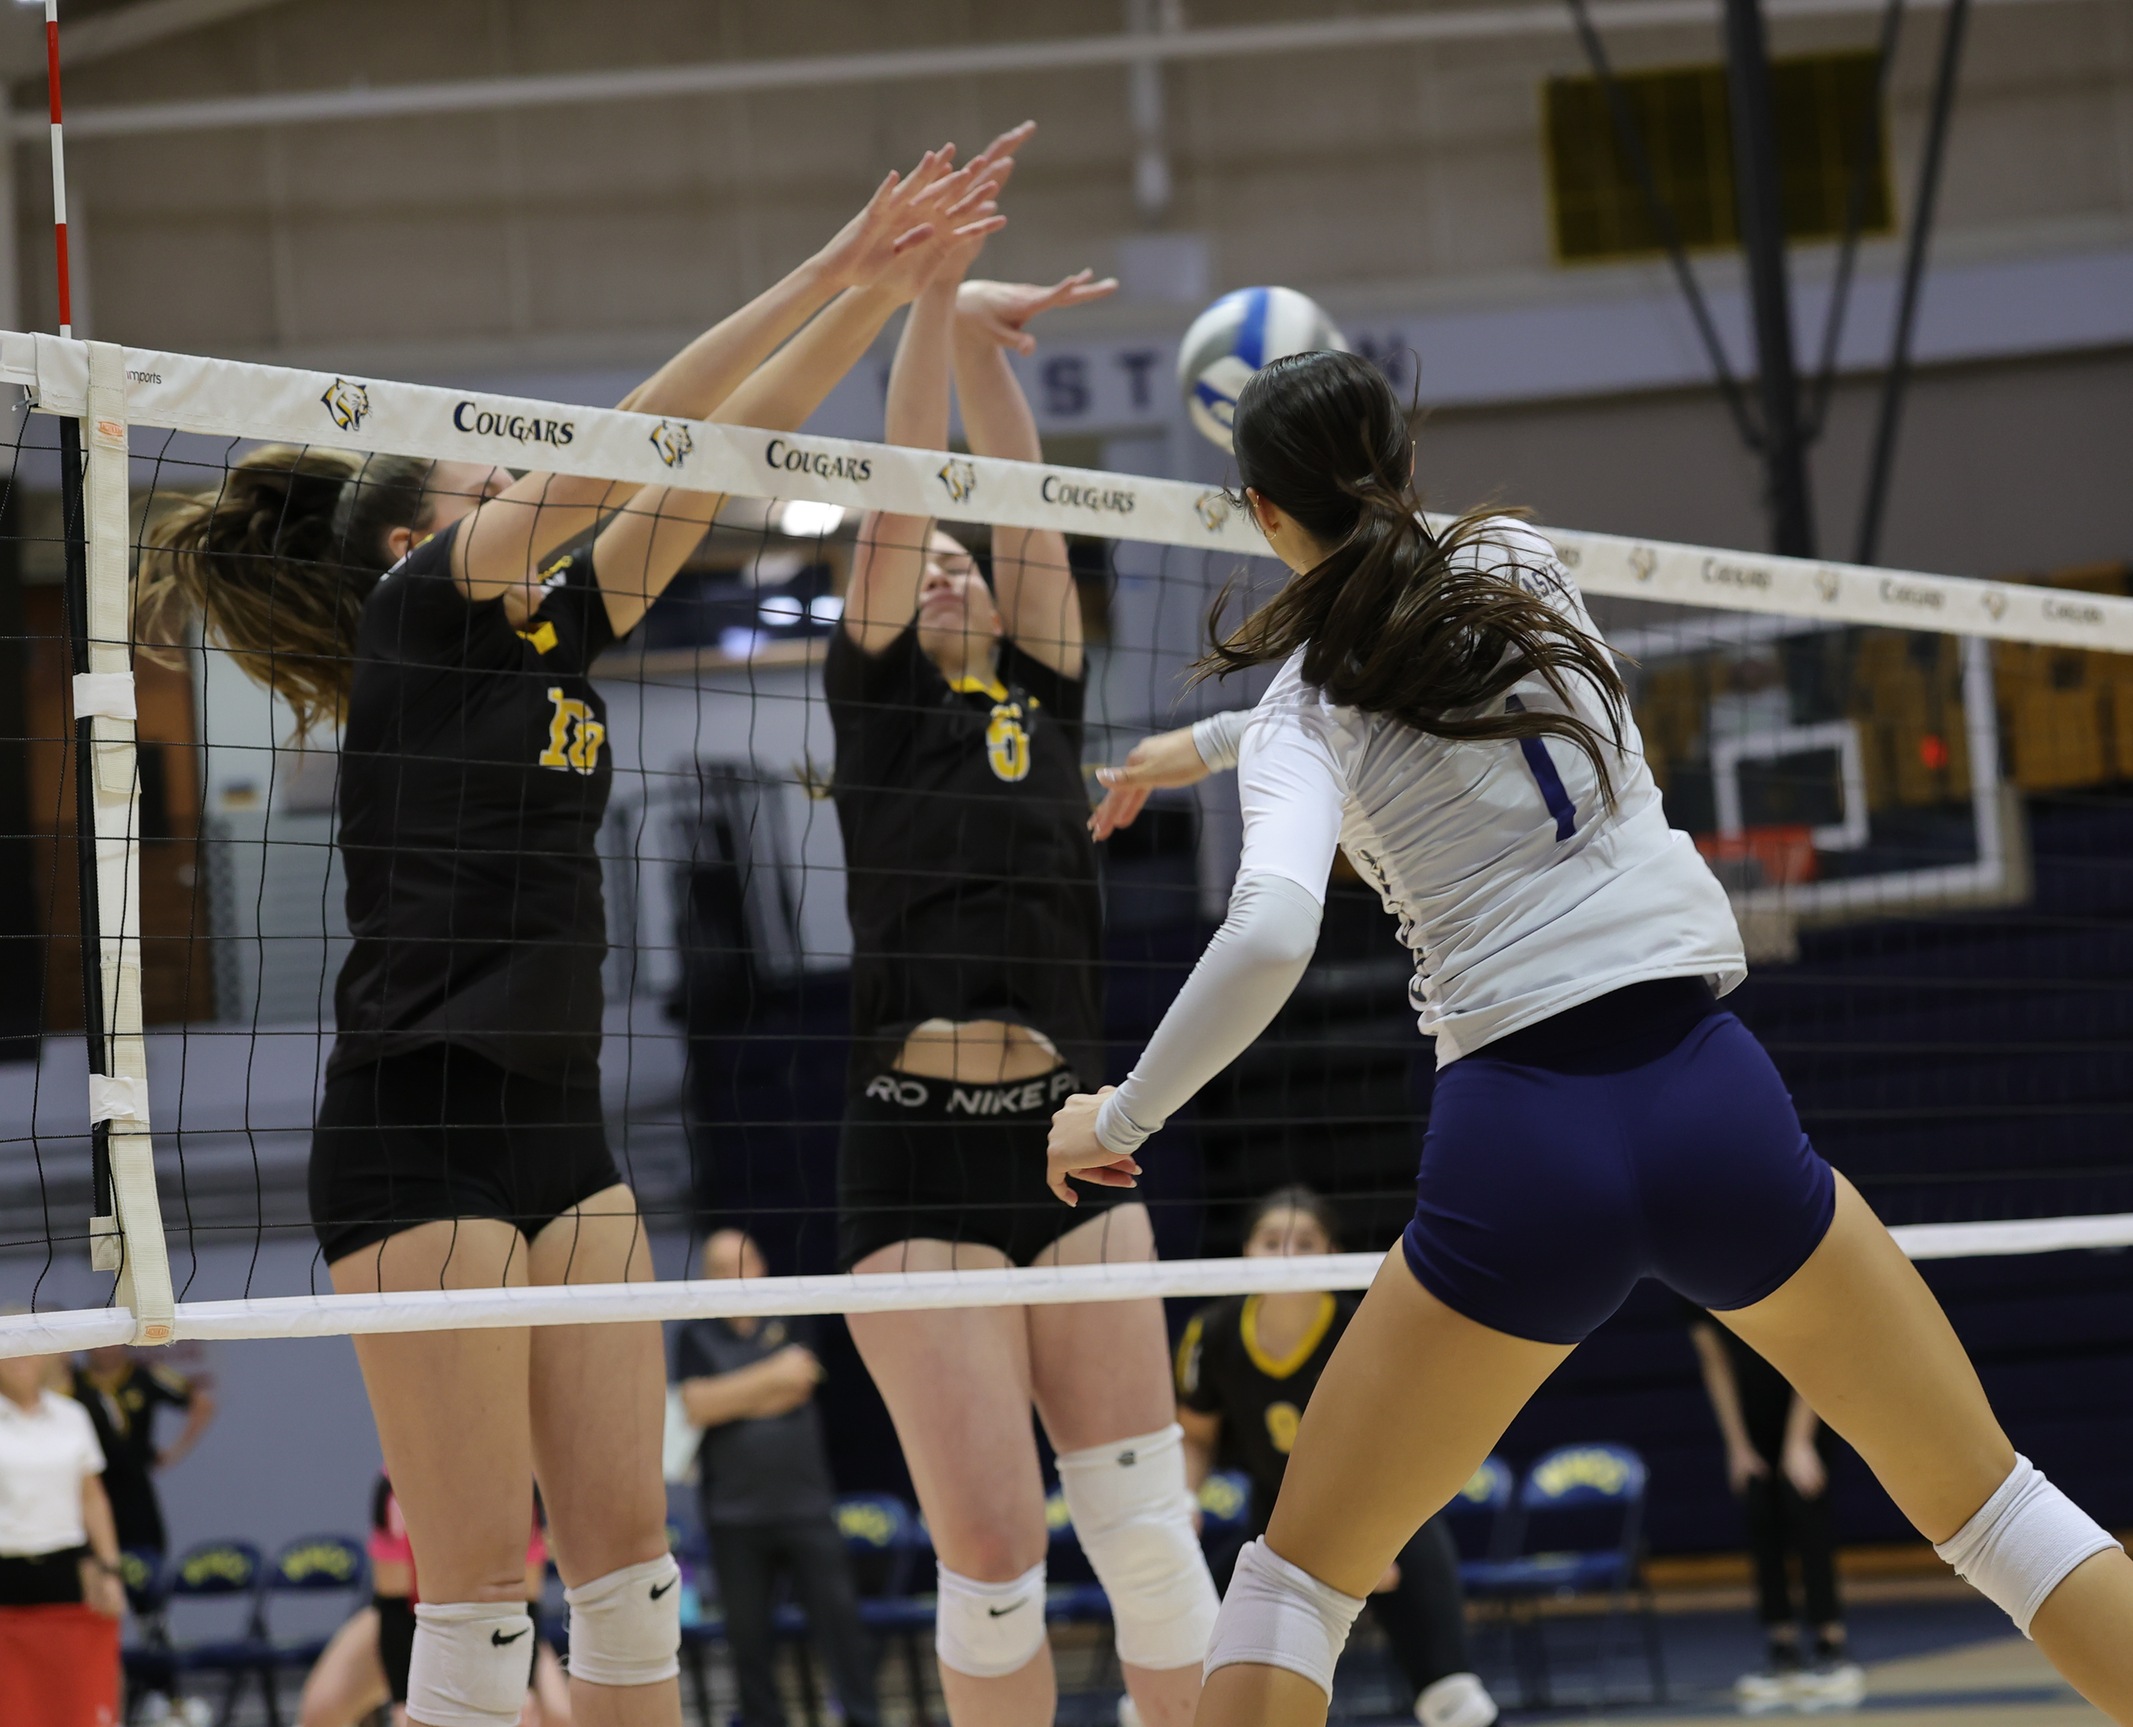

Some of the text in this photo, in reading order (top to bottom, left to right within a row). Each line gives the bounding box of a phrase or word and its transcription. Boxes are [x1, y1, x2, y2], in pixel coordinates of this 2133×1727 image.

[453, 400, 575, 449] COUGARS
[1504, 693, 1577, 842] 1
[945, 1080, 1047, 1115] NIKE
